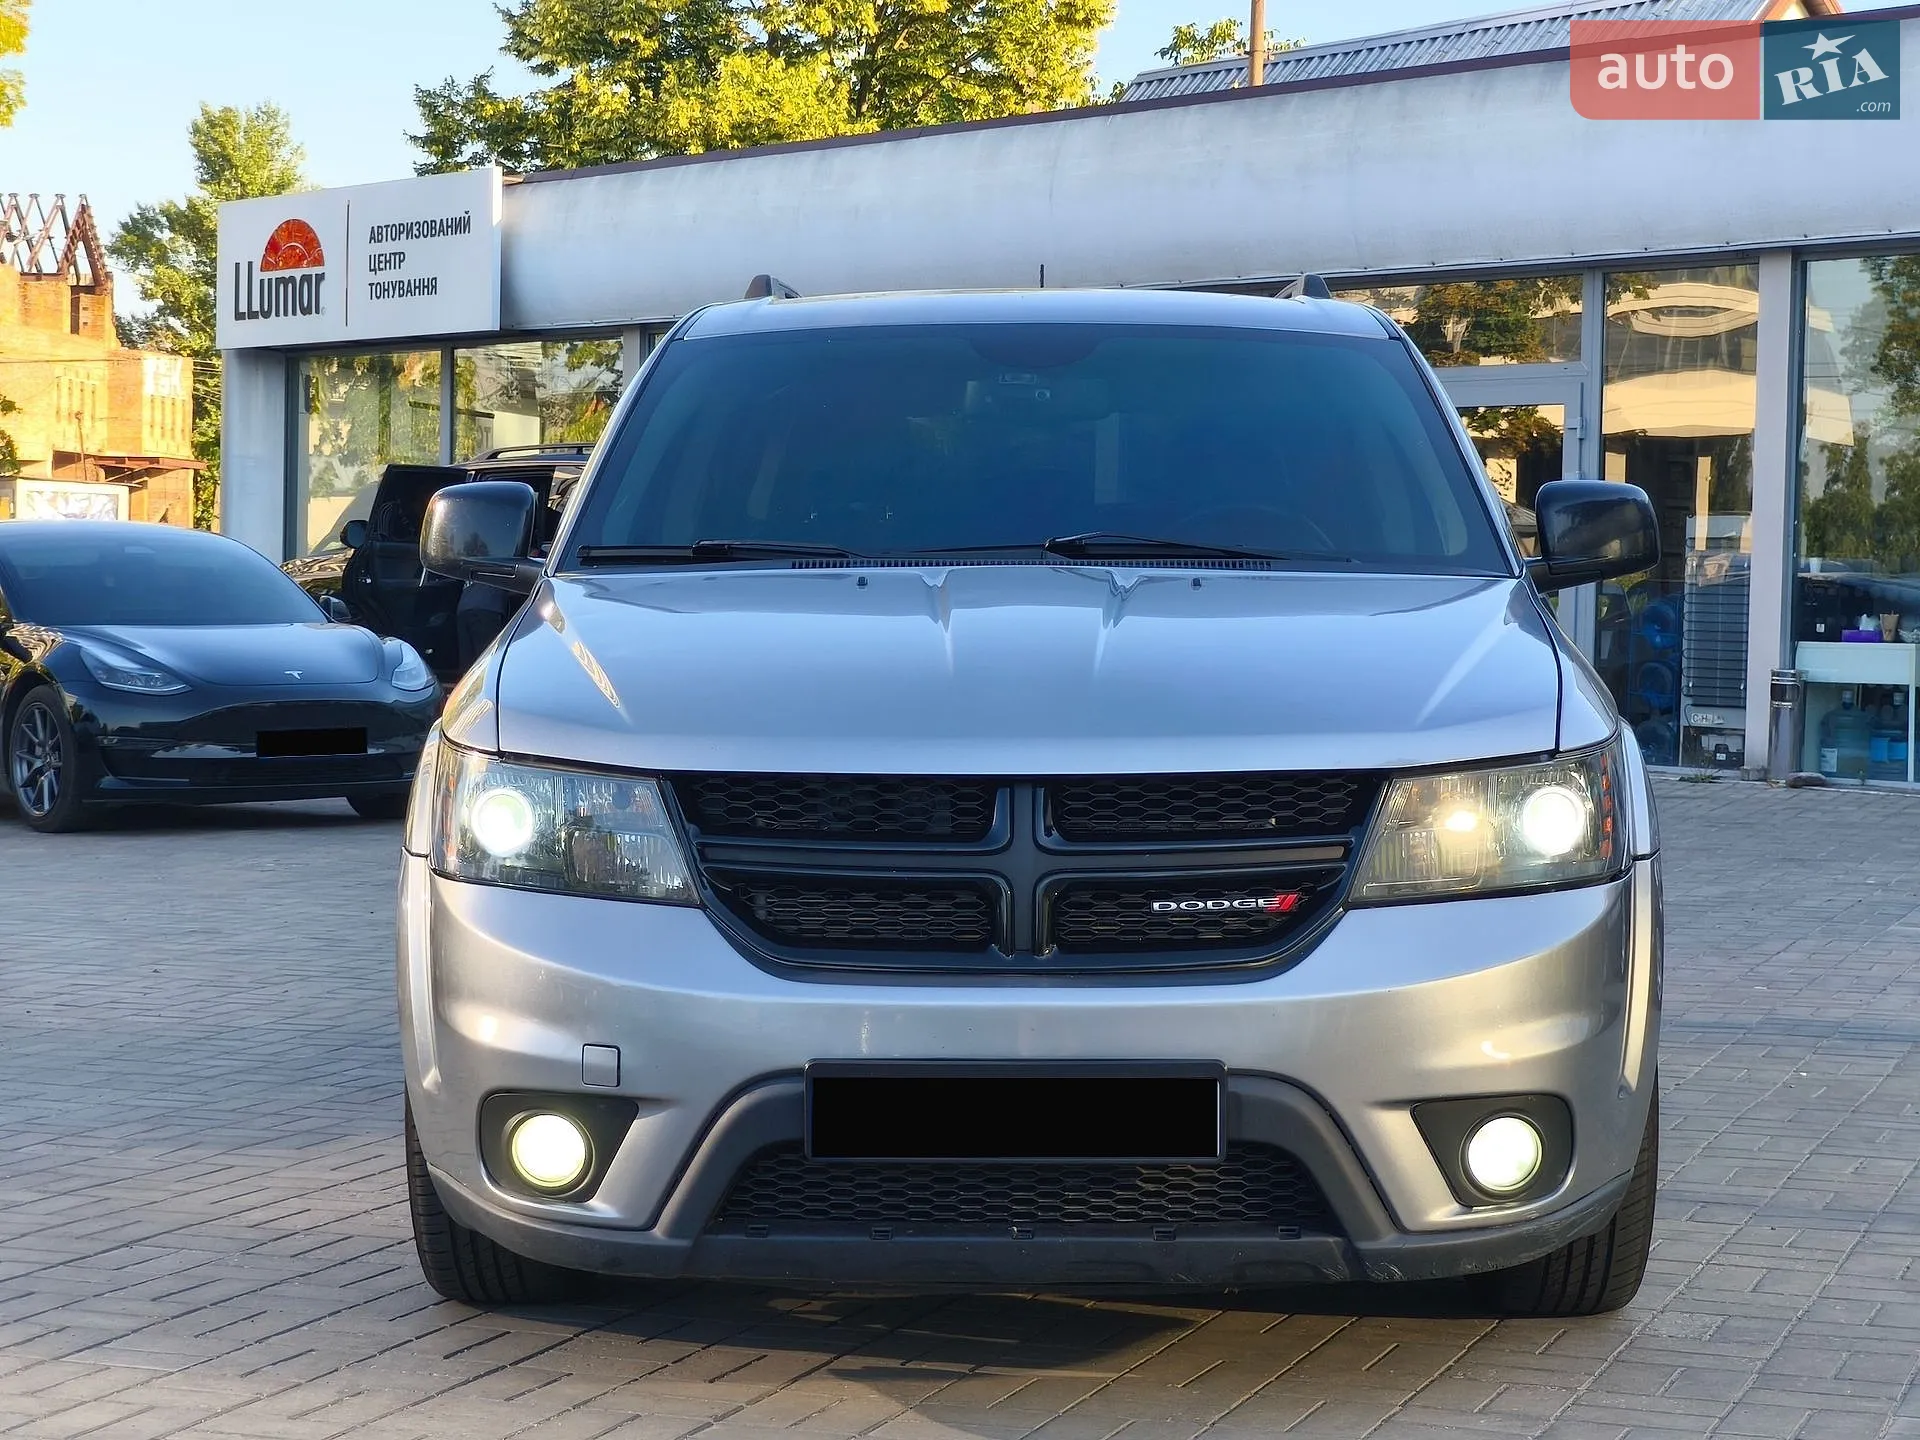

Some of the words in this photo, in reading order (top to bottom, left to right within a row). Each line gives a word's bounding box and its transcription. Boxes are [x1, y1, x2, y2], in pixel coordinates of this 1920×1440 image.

[368, 210, 471, 244] АВТОРИЗОВАНИЙ
[368, 251, 406, 275] ЦЕНТР
[234, 260, 325, 321] LLumar
[368, 276, 438, 300] ТОНУВАННЯ
[1152, 897, 1281, 912] DODGE
